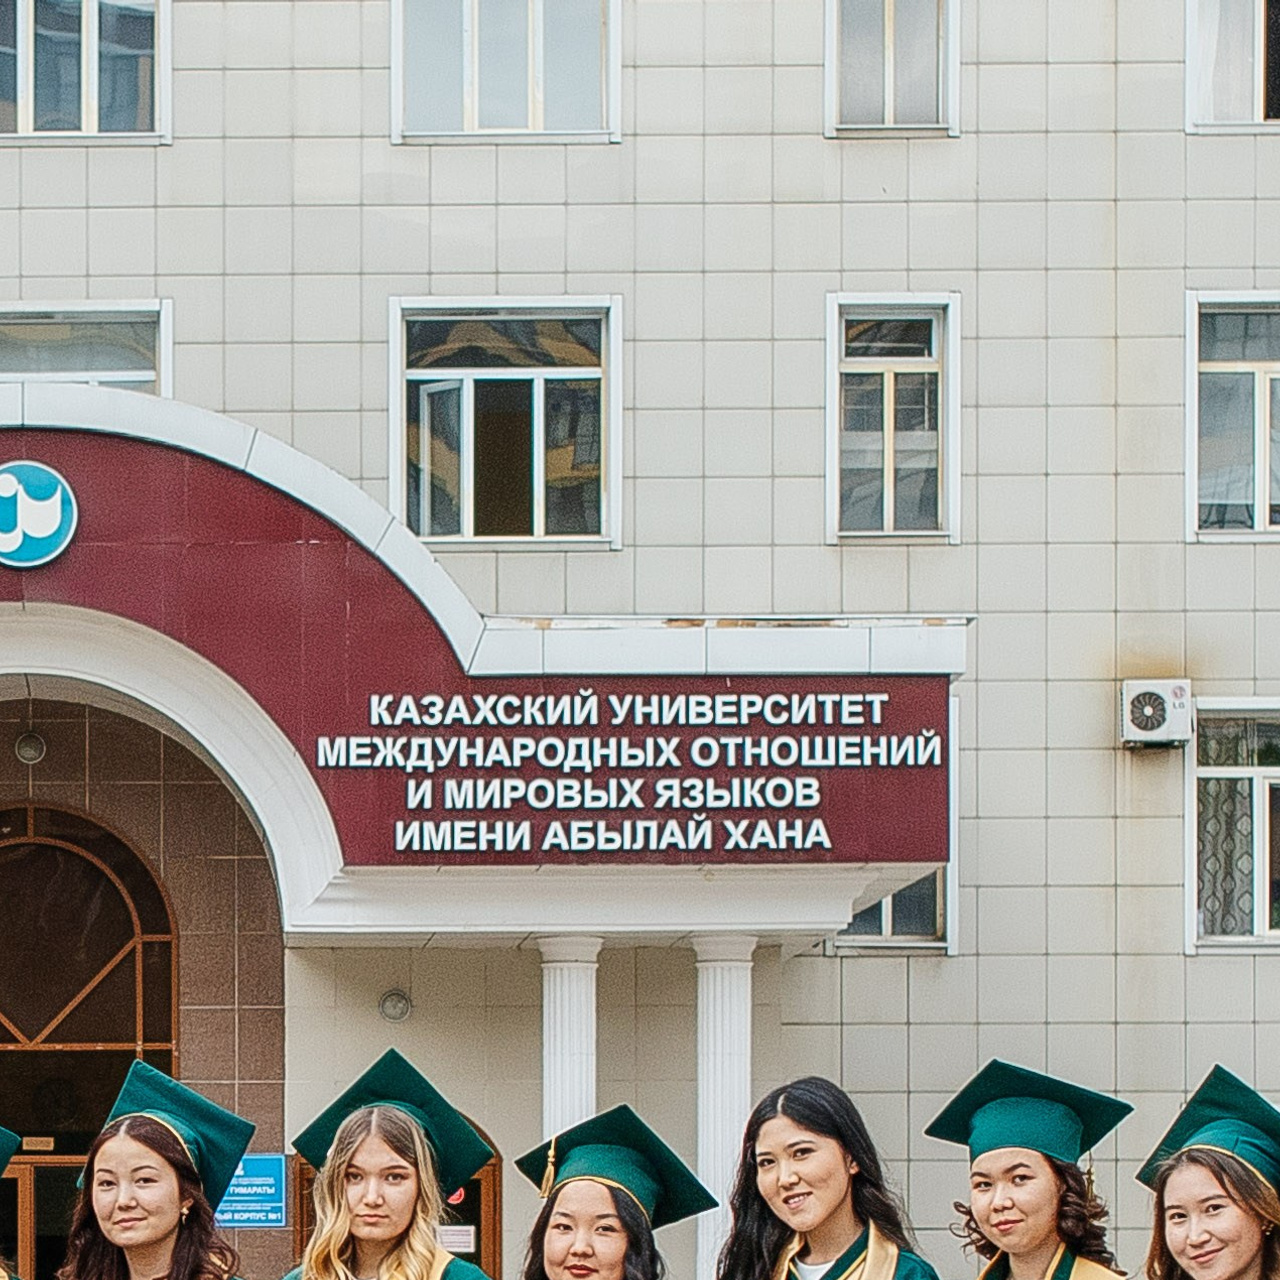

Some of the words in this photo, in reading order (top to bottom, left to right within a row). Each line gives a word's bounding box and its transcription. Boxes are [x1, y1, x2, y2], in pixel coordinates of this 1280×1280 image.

[370, 688, 599, 726] КАЗАХСКИЙ
[609, 694, 889, 725] УНИВЕРСИТЕТ
[1172, 701, 1186, 710] LG
[317, 736, 681, 773] МЕЖДУНАРОДНЫХ
[690, 729, 942, 767] ОТНОШЕНИЙ
[407, 778, 433, 809] И
[444, 778, 645, 809] МИРОВЫХ
[654, 777, 821, 809] ЯЗЫКОВ
[395, 821, 531, 850] ИМЕНИ
[542, 812, 711, 851] АБЫЛАЙ
[723, 819, 832, 850] ХАНА
[234, 1212, 267, 1220] КОРПУС
